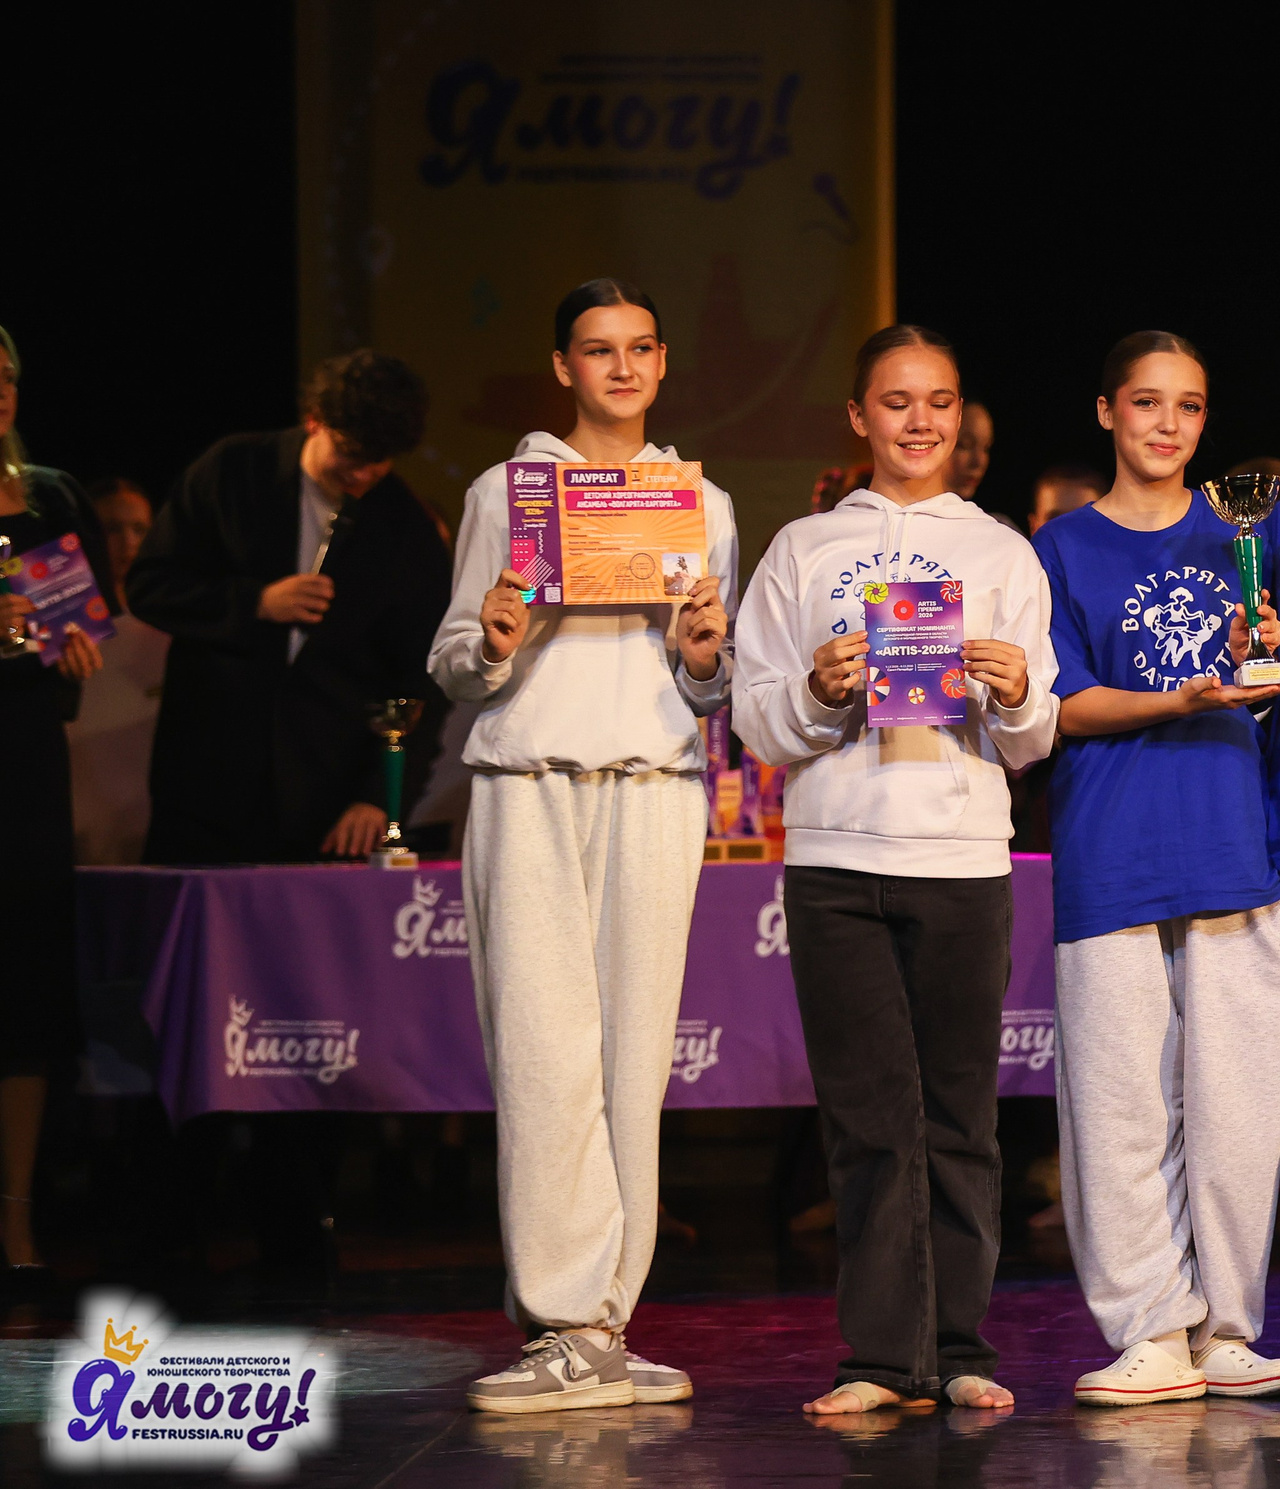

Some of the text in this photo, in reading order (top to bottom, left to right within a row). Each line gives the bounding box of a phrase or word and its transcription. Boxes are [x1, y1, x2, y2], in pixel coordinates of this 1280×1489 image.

[570, 473, 619, 484] ЛАУРЕАТ
[830, 551, 953, 601] ВОЛГАРЯТ
[875, 644, 958, 656] «ARTIS-2026»
[246, 1028, 360, 1085] могу!
